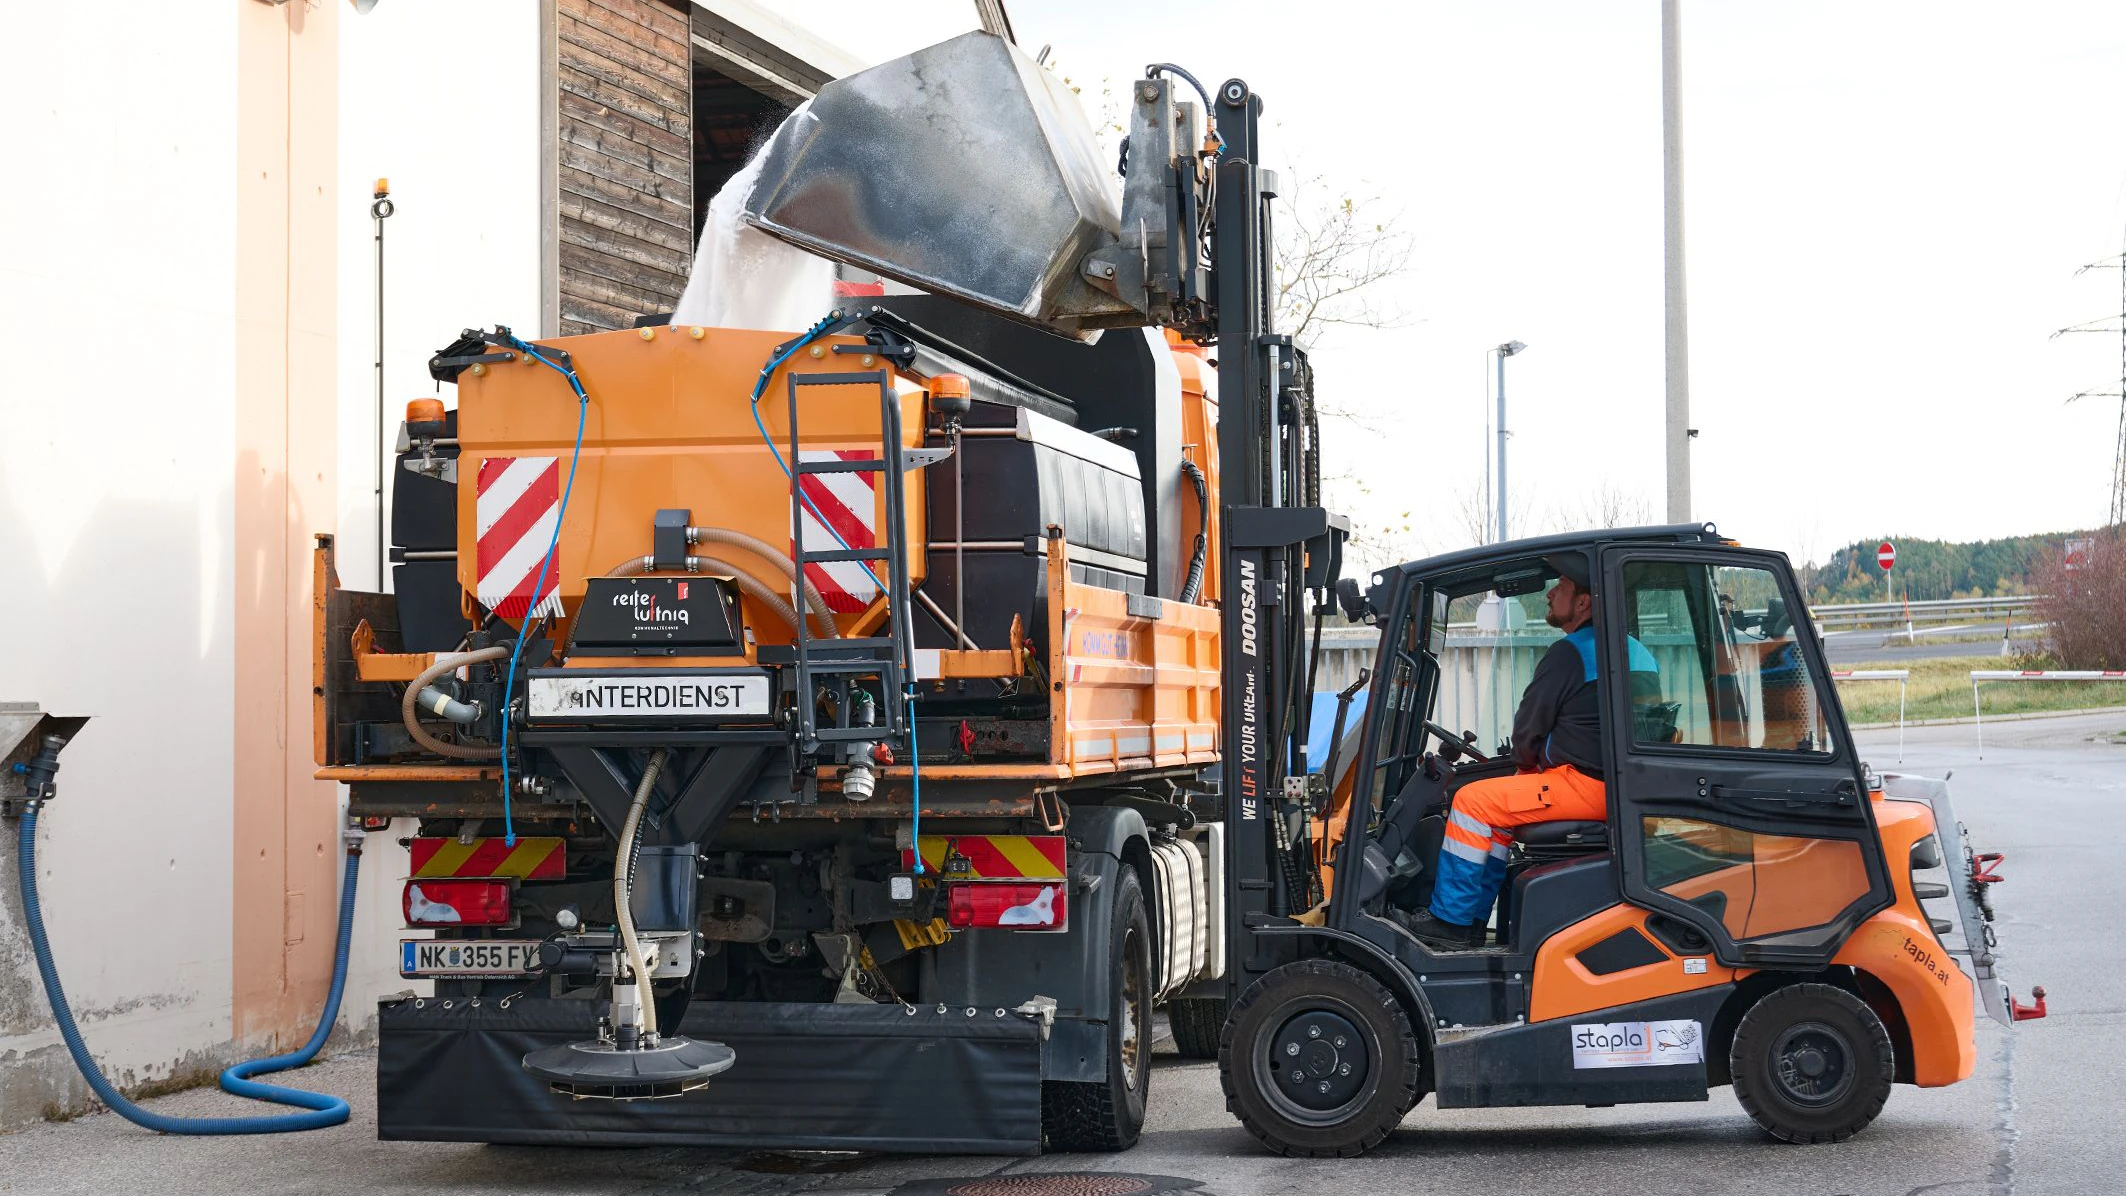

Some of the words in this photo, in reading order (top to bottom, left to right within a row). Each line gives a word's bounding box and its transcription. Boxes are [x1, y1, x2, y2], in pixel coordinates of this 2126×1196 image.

[1240, 559, 1257, 657] DOOSAN
[570, 685, 745, 708] INTERDIENST
[1241, 726, 1256, 763] YOUR
[1241, 765, 1257, 797] LIFT
[1242, 798, 1257, 820] WE
[420, 945, 446, 968] NK
[462, 945, 502, 968] 355
[1576, 1026, 1643, 1052] stapla
